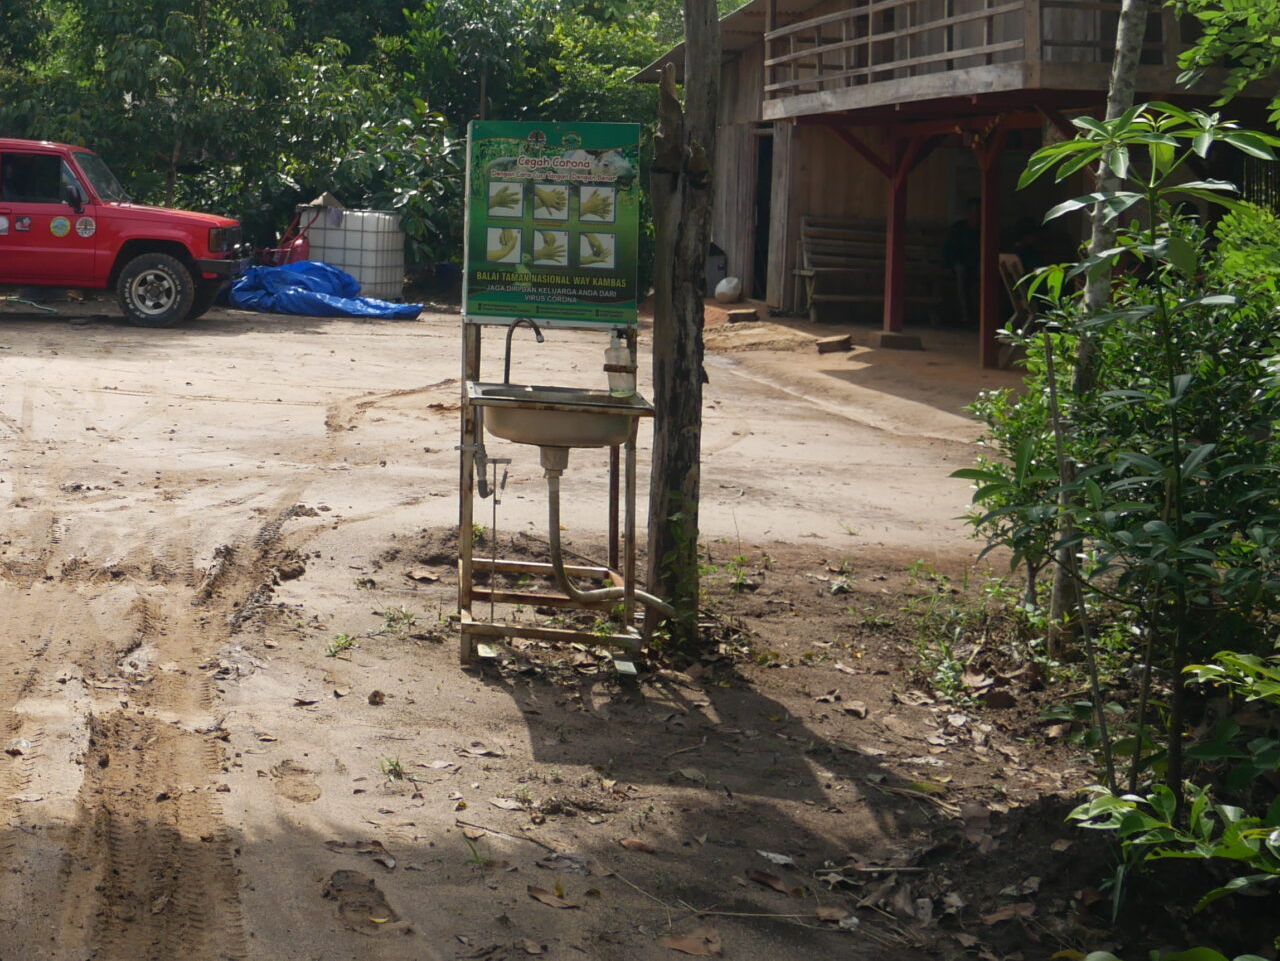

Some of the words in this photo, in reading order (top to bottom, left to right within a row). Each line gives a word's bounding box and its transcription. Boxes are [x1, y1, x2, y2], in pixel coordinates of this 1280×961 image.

[518, 155, 550, 169] Cegah
[552, 157, 591, 169] Corona
[476, 271, 499, 281] BALAI
[502, 272, 529, 282] TAMAN
[531, 274, 570, 284] NASIONAL
[573, 277, 590, 286] WAY
[592, 277, 626, 288] KAMBAS
[538, 288, 577, 296] KELUARGA
[524, 294, 546, 302] VIRUS
[547, 296, 577, 304] CORONA
